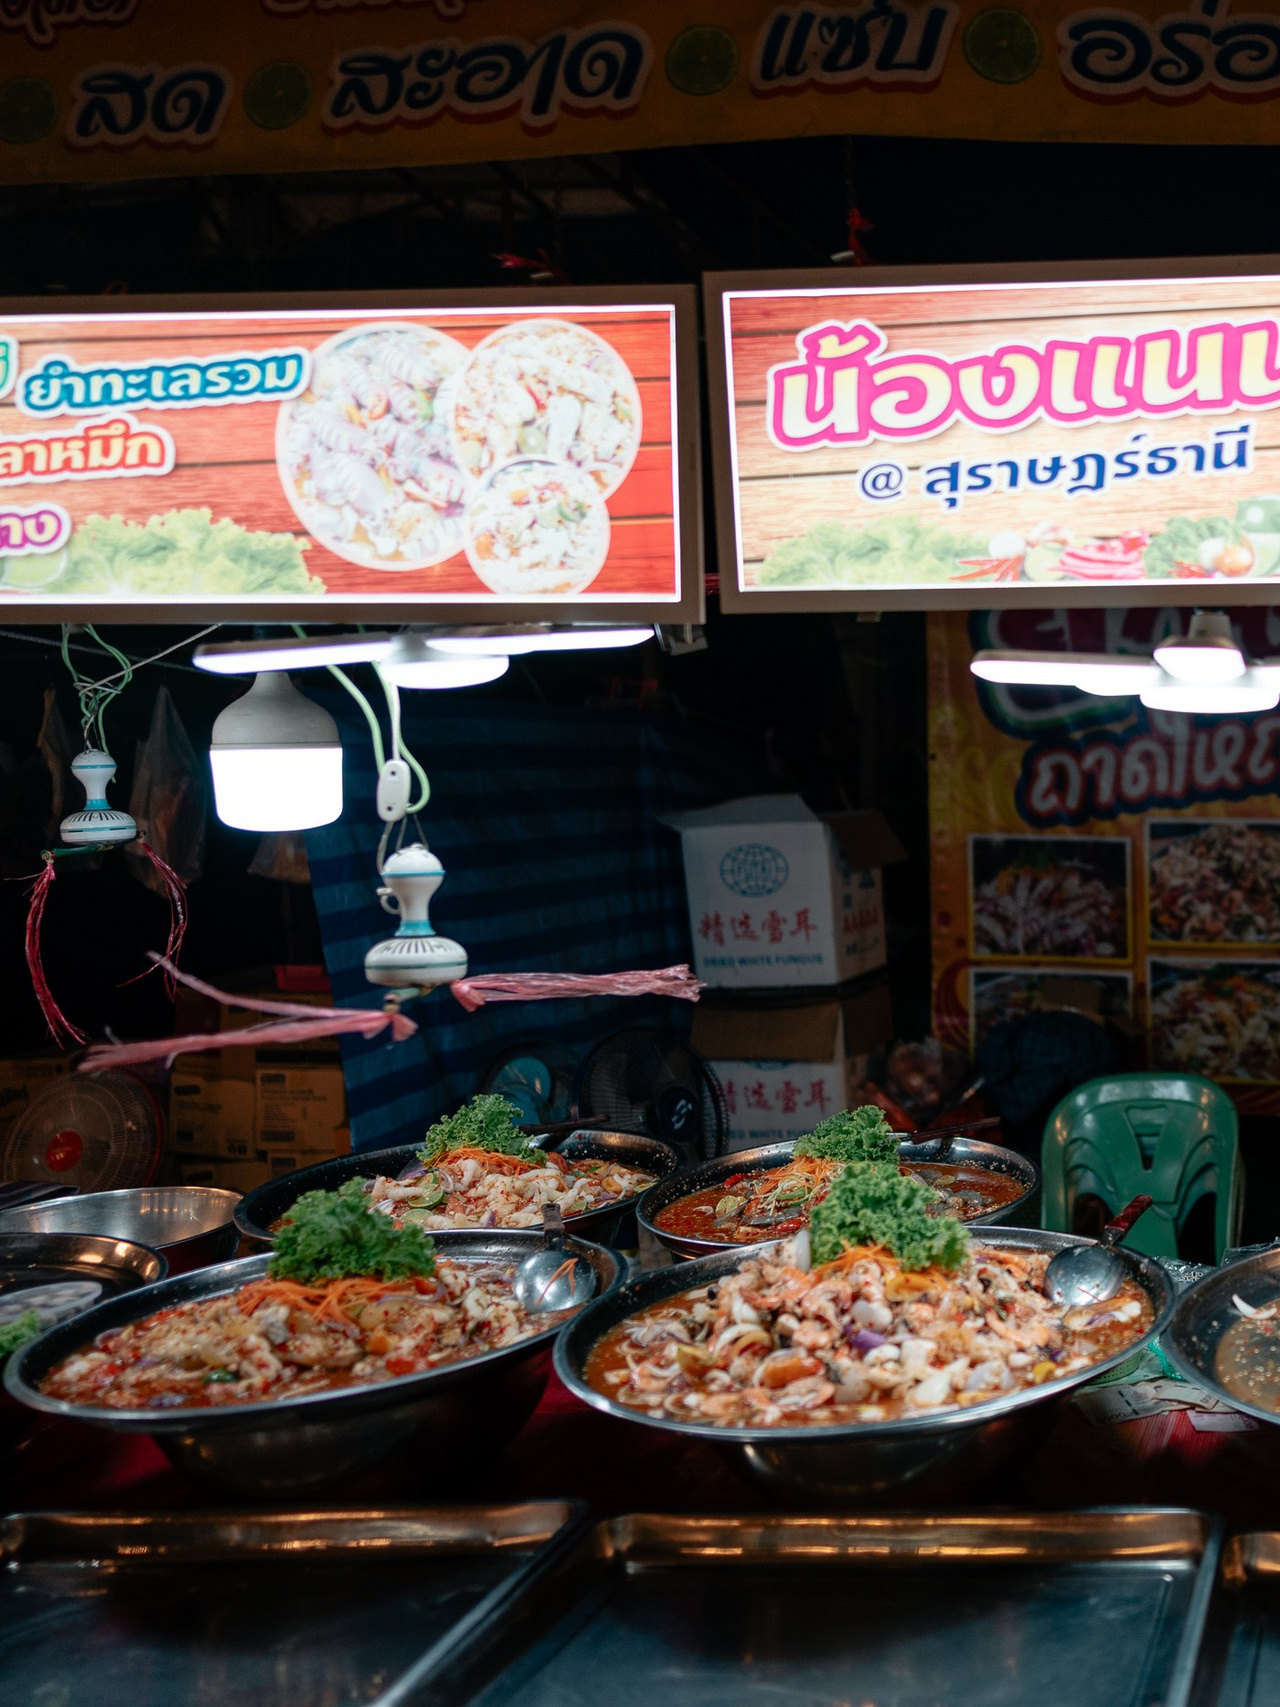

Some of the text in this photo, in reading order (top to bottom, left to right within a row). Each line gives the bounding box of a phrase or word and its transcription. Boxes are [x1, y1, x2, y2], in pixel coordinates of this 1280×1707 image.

[73, 66, 230, 142] สด
[326, 26, 648, 122] สะอาด
[23, 352, 307, 411] ยำทะเลรวม
[861, 424, 1249, 509] @ สุราษฎร์ธานี
